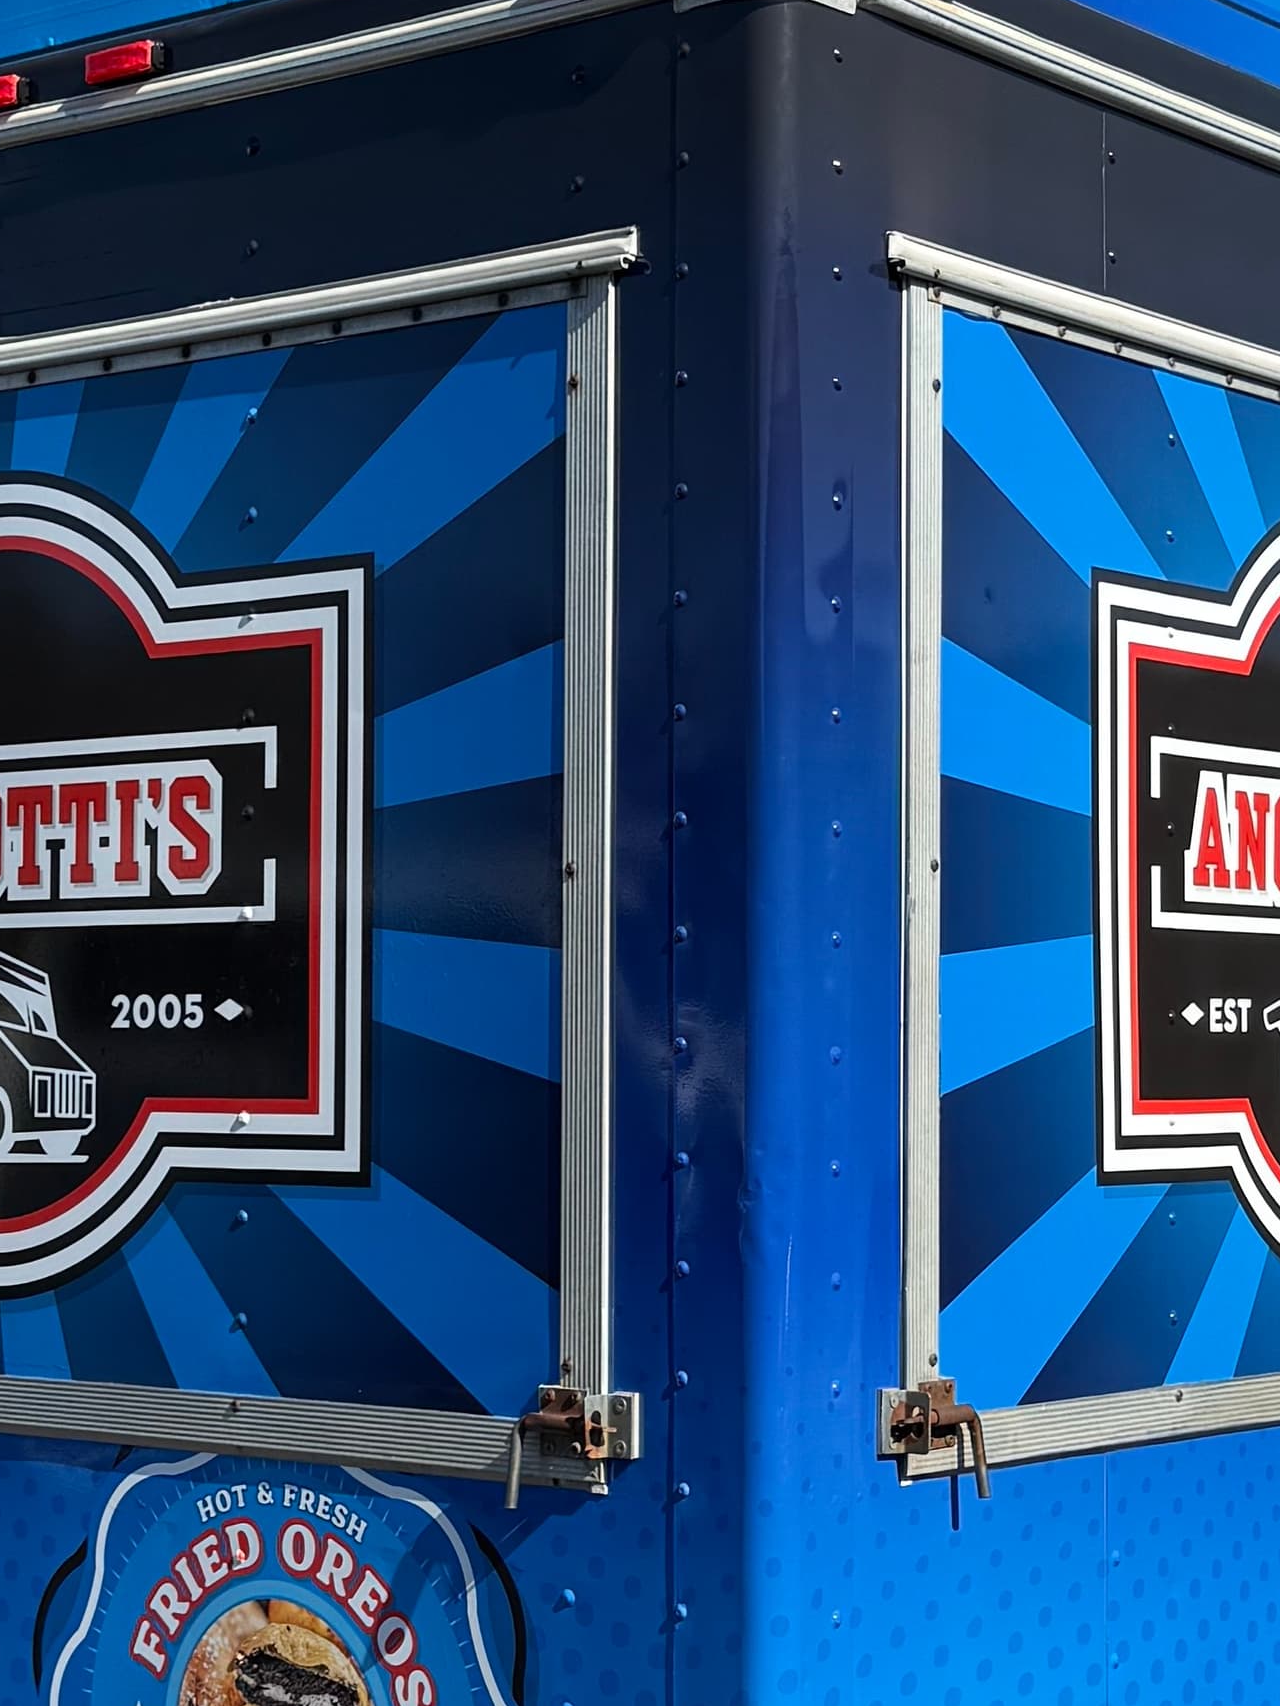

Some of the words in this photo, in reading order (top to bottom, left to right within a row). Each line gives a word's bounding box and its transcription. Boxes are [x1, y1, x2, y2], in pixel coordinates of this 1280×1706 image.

[110, 993, 205, 1031] 2005
[1208, 997, 1252, 1034] EST
[196, 1485, 248, 1524] HOT
[256, 1481, 274, 1506] &
[282, 1484, 369, 1544] FRESH
[131, 1517, 264, 1680] FRIED
